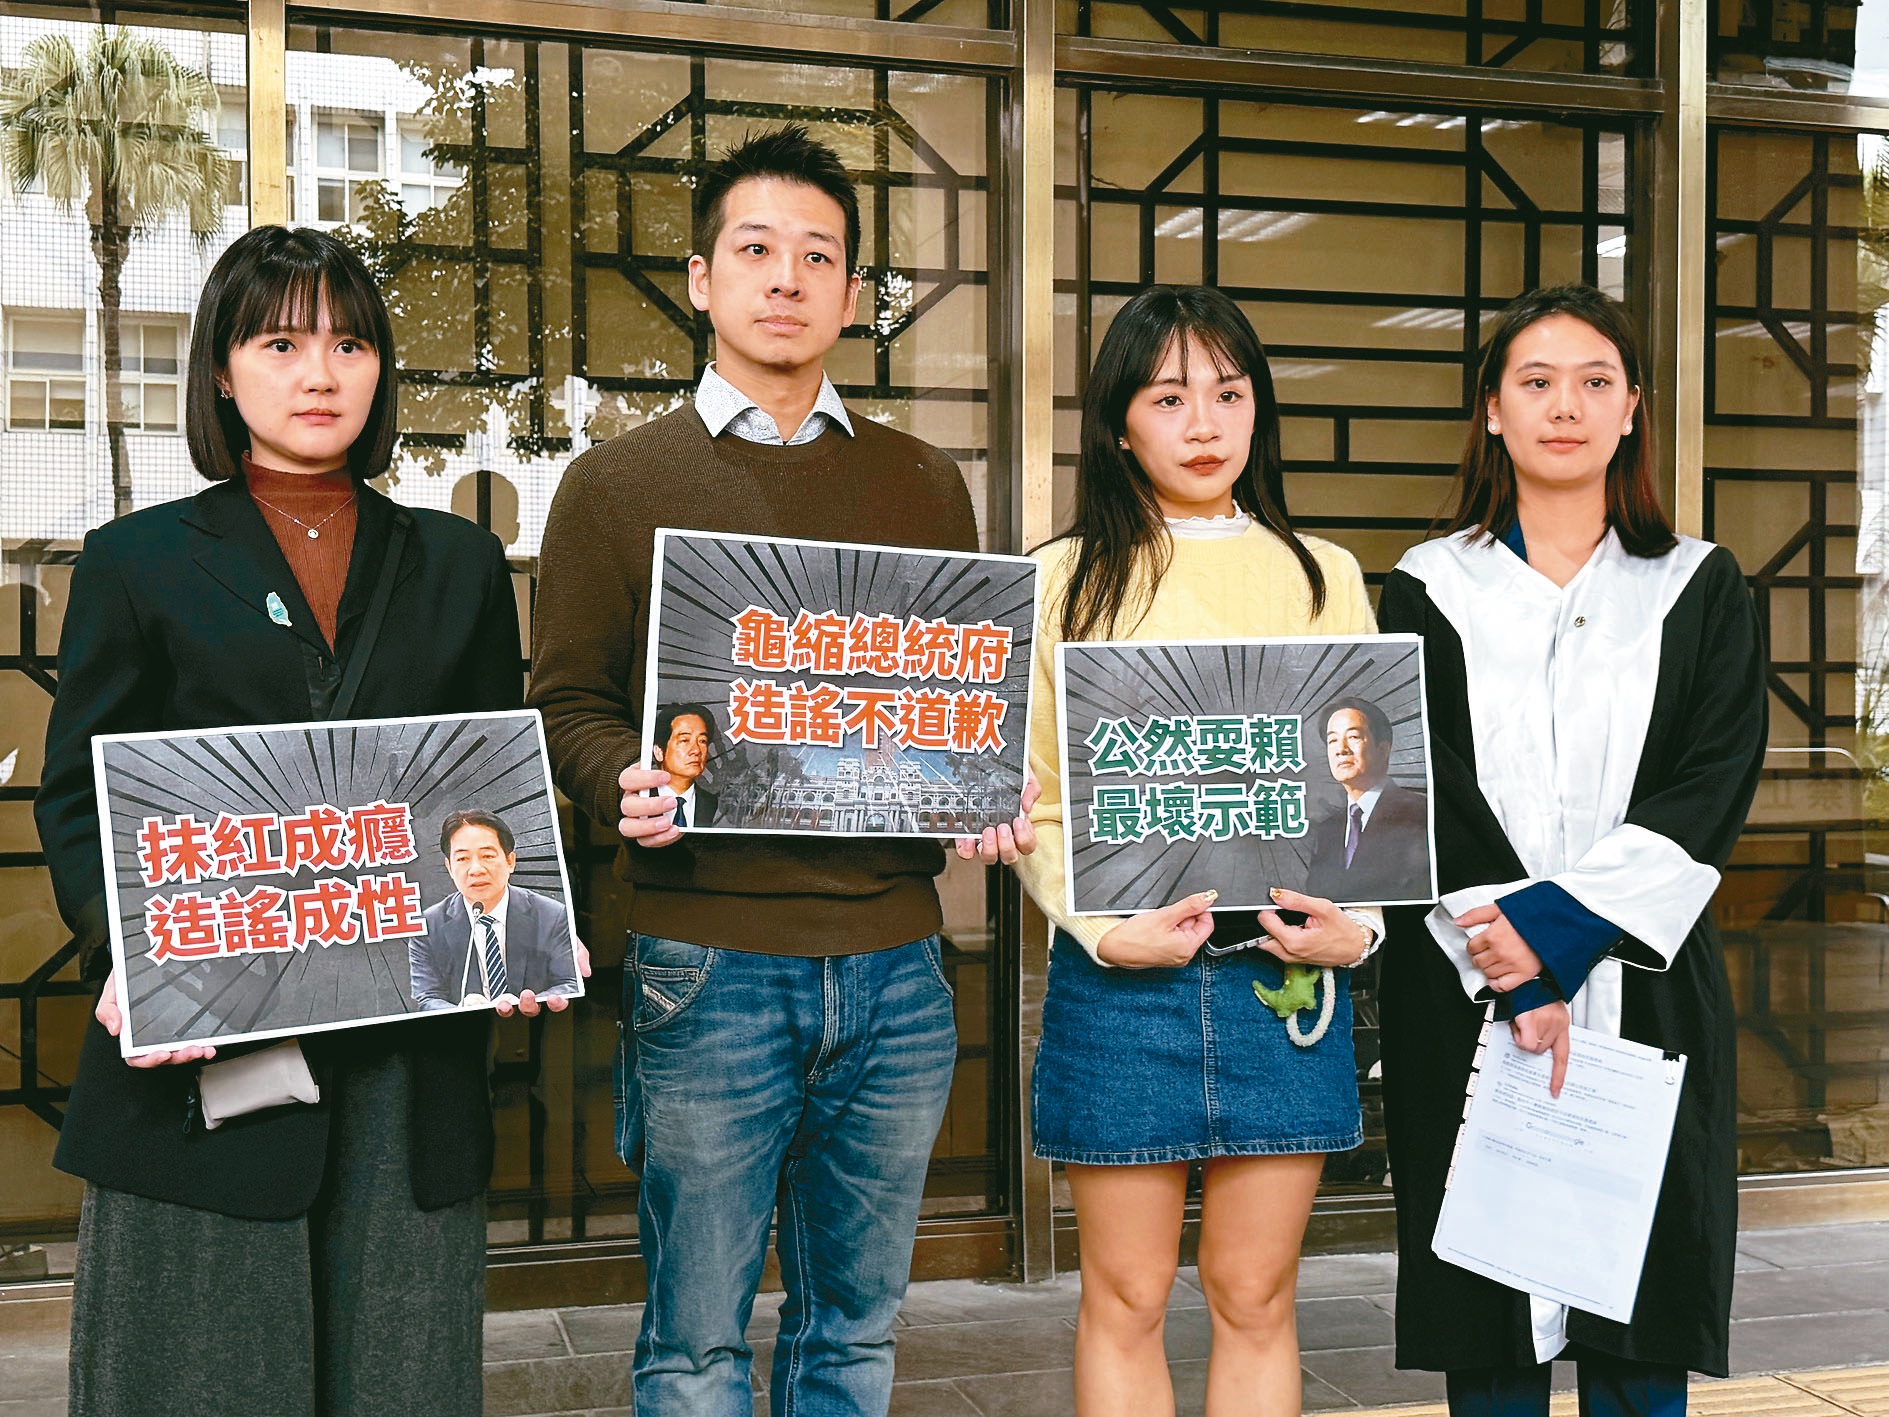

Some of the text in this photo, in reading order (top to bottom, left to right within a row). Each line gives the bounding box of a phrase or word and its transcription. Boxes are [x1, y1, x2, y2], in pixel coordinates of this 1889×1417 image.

[733, 607, 1011, 682] 龜縮總統府
[728, 679, 1006, 753] 造謠不道歉
[1086, 715, 1305, 775] 公然耍賴
[139, 801, 416, 886] 抹紅成癮
[1090, 780, 1307, 842] 最壞示範
[147, 874, 425, 963] 造謠成性
